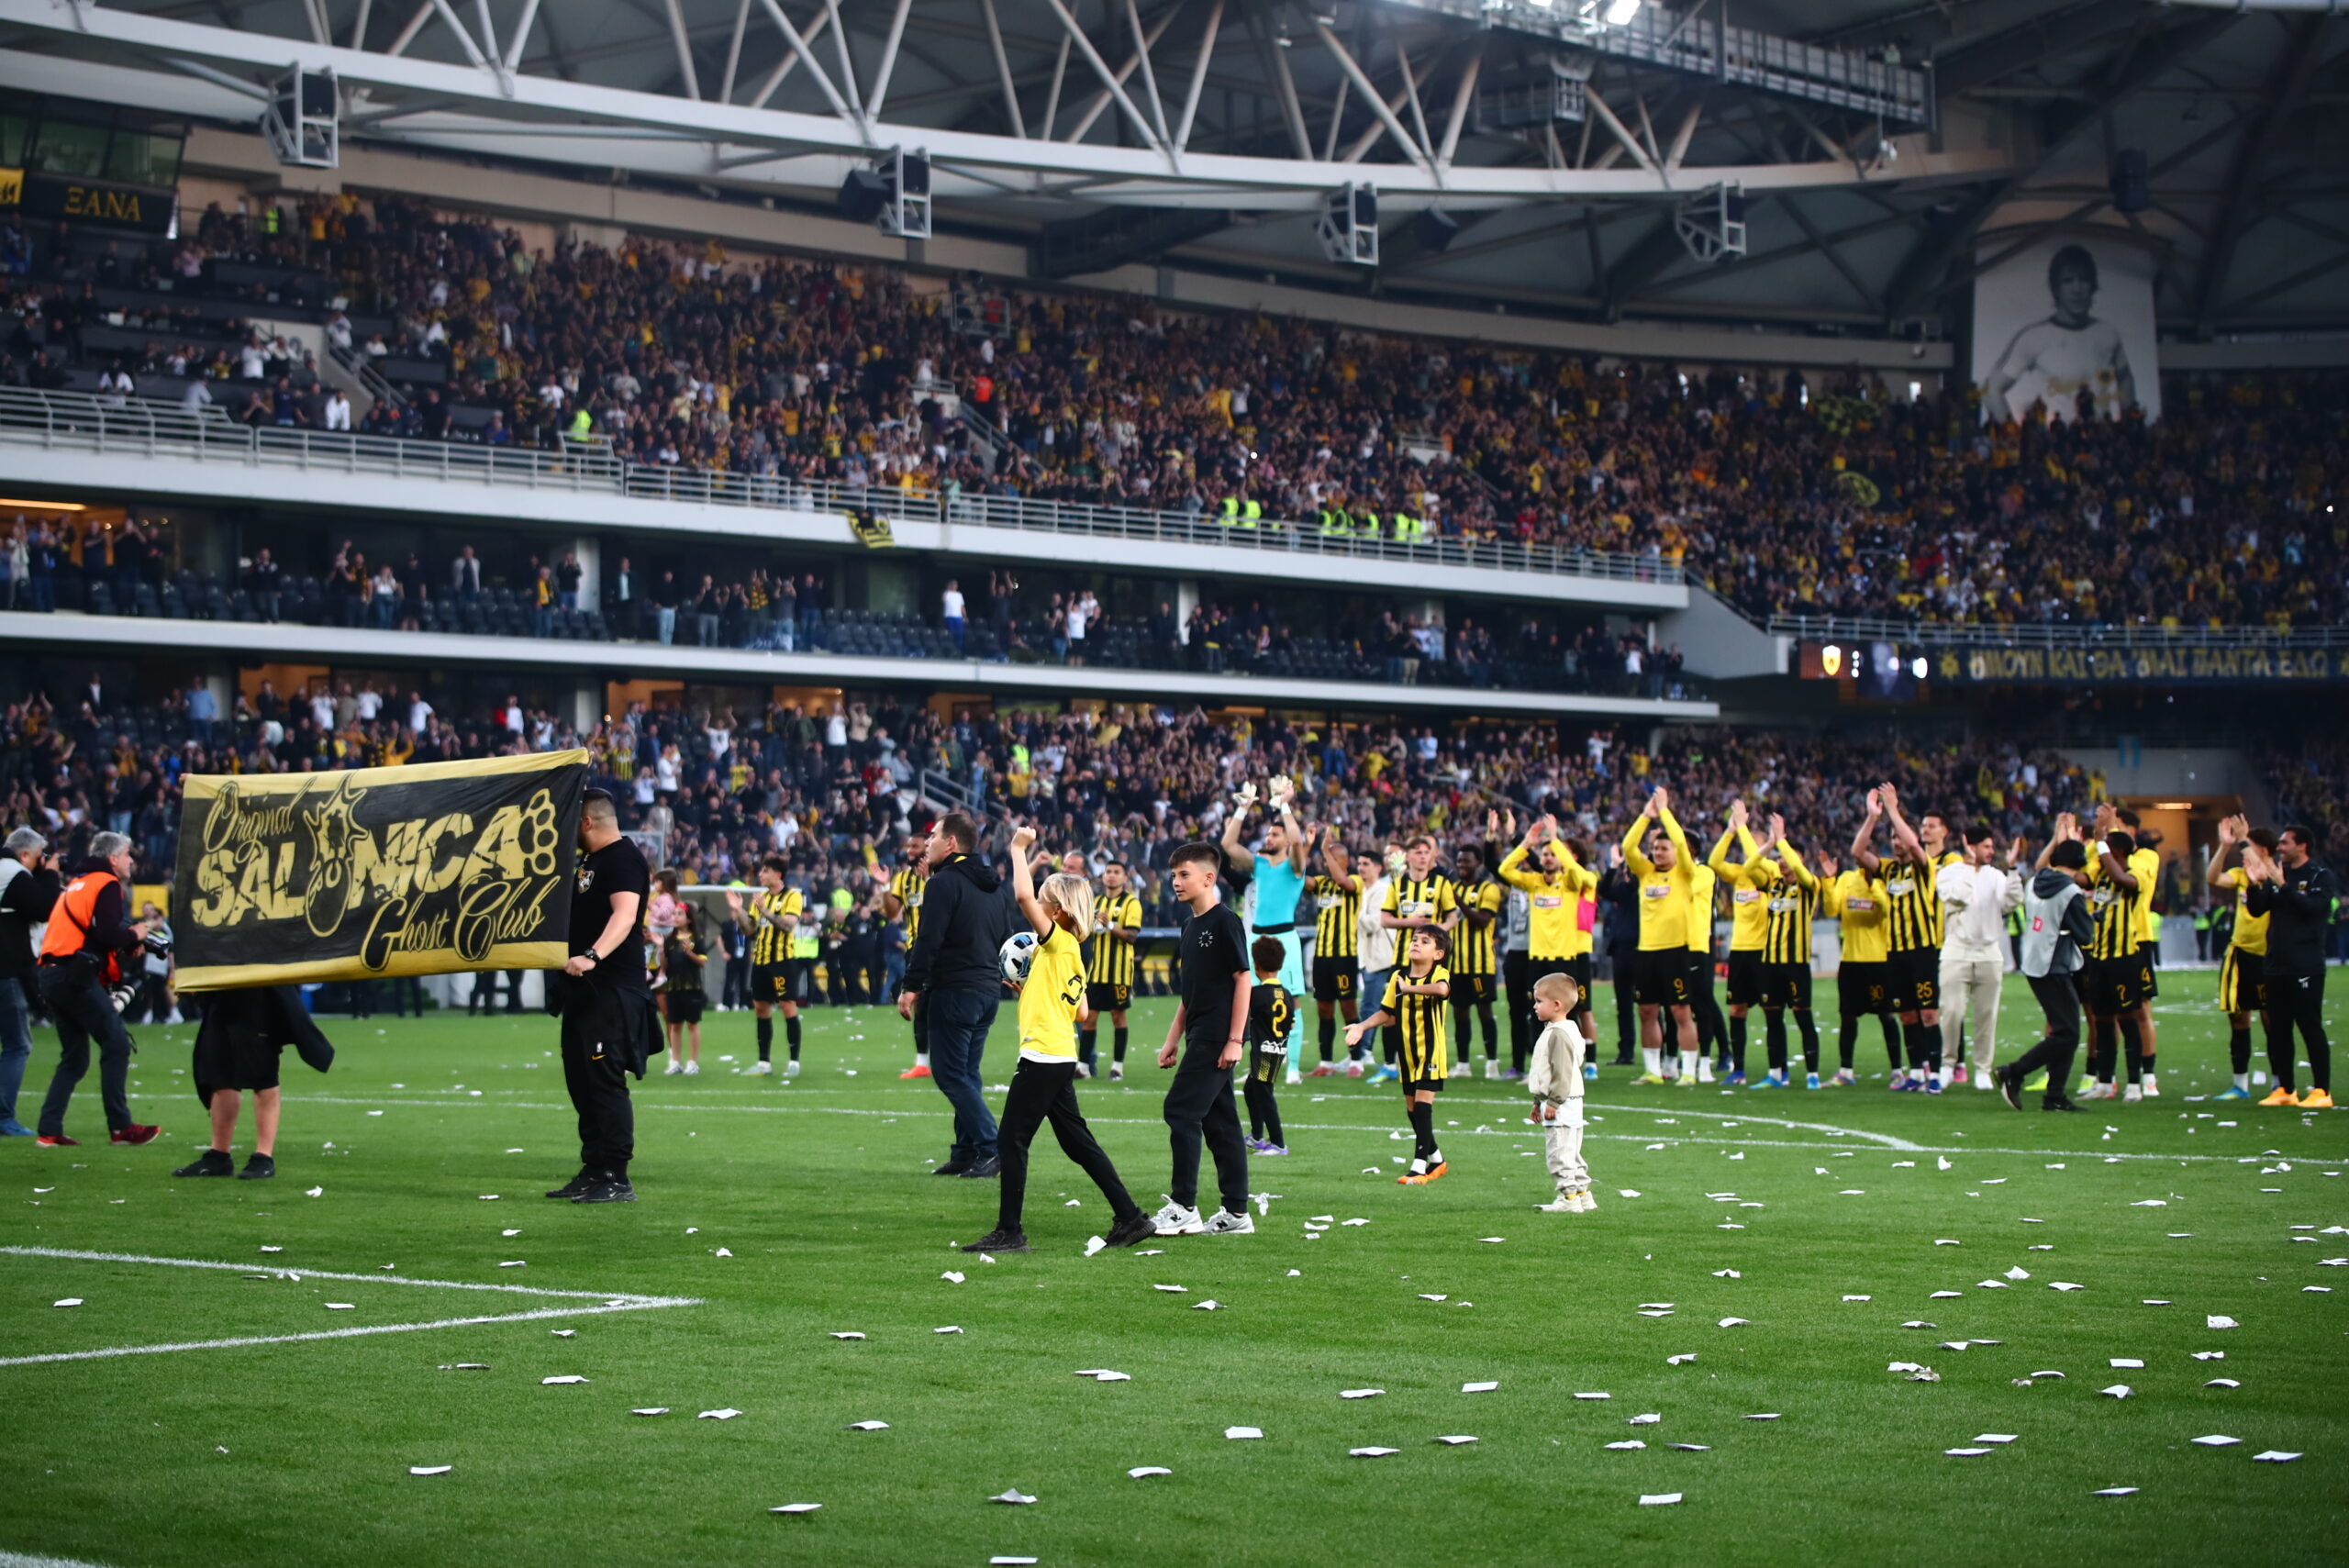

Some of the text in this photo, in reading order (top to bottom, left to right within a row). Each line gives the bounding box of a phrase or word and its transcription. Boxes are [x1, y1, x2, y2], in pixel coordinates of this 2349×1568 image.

[63, 185, 142, 221] ΞΑΝΑ
[204, 778, 317, 864] Original
[361, 873, 562, 972] Ghost Club
[1336, 974, 1350, 990] 10
[1472, 977, 1484, 993] 11
[1674, 977, 1684, 994] 9
[1916, 980, 1933, 999] 25
[1113, 984, 1128, 1000] 13
[1272, 998, 1287, 1039] 2
